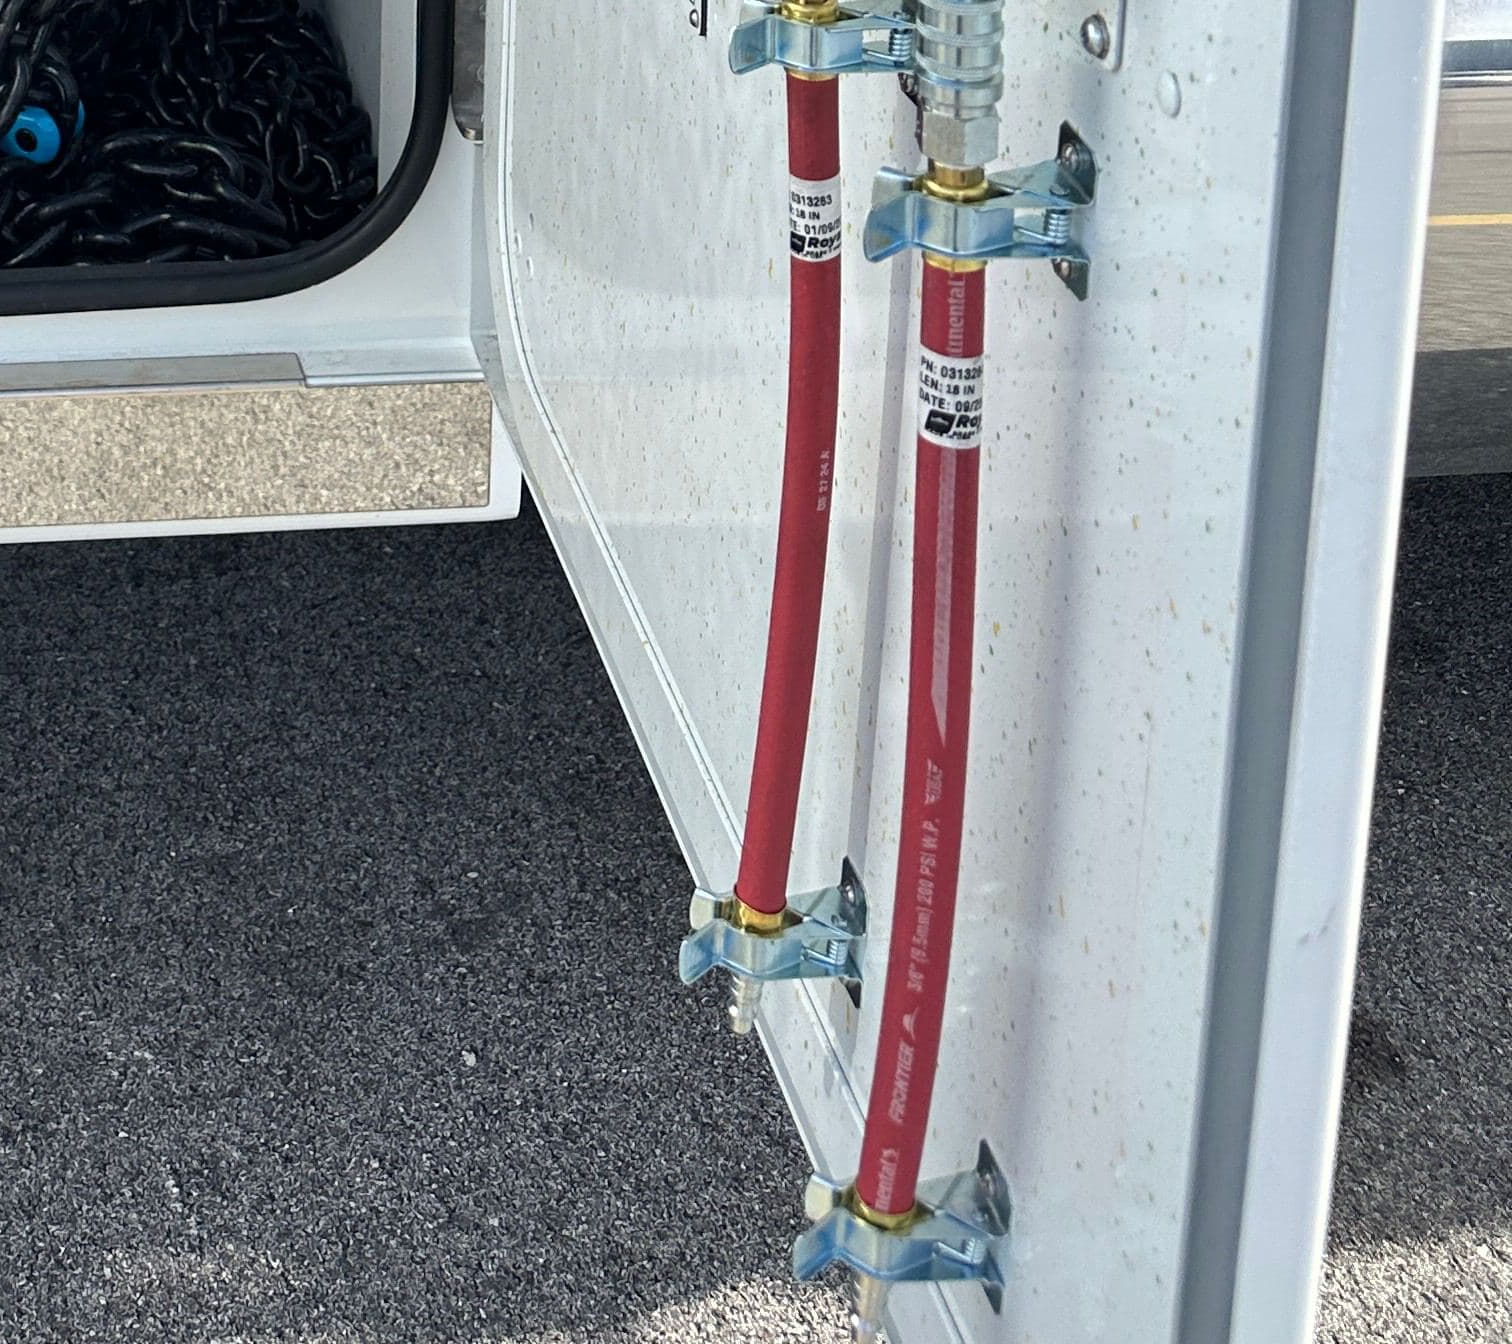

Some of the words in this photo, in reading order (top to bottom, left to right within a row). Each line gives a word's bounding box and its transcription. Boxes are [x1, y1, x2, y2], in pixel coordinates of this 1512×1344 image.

[808, 210, 820, 220] IN
[920, 354, 938, 375] PN:
[919, 370, 943, 393] LEN:
[963, 384, 976, 395] IN
[919, 387, 951, 410] DATE:
[922, 818, 940, 849] W.P.
[919, 851, 936, 877] PSI
[888, 1040, 914, 1123] FRONTIER
